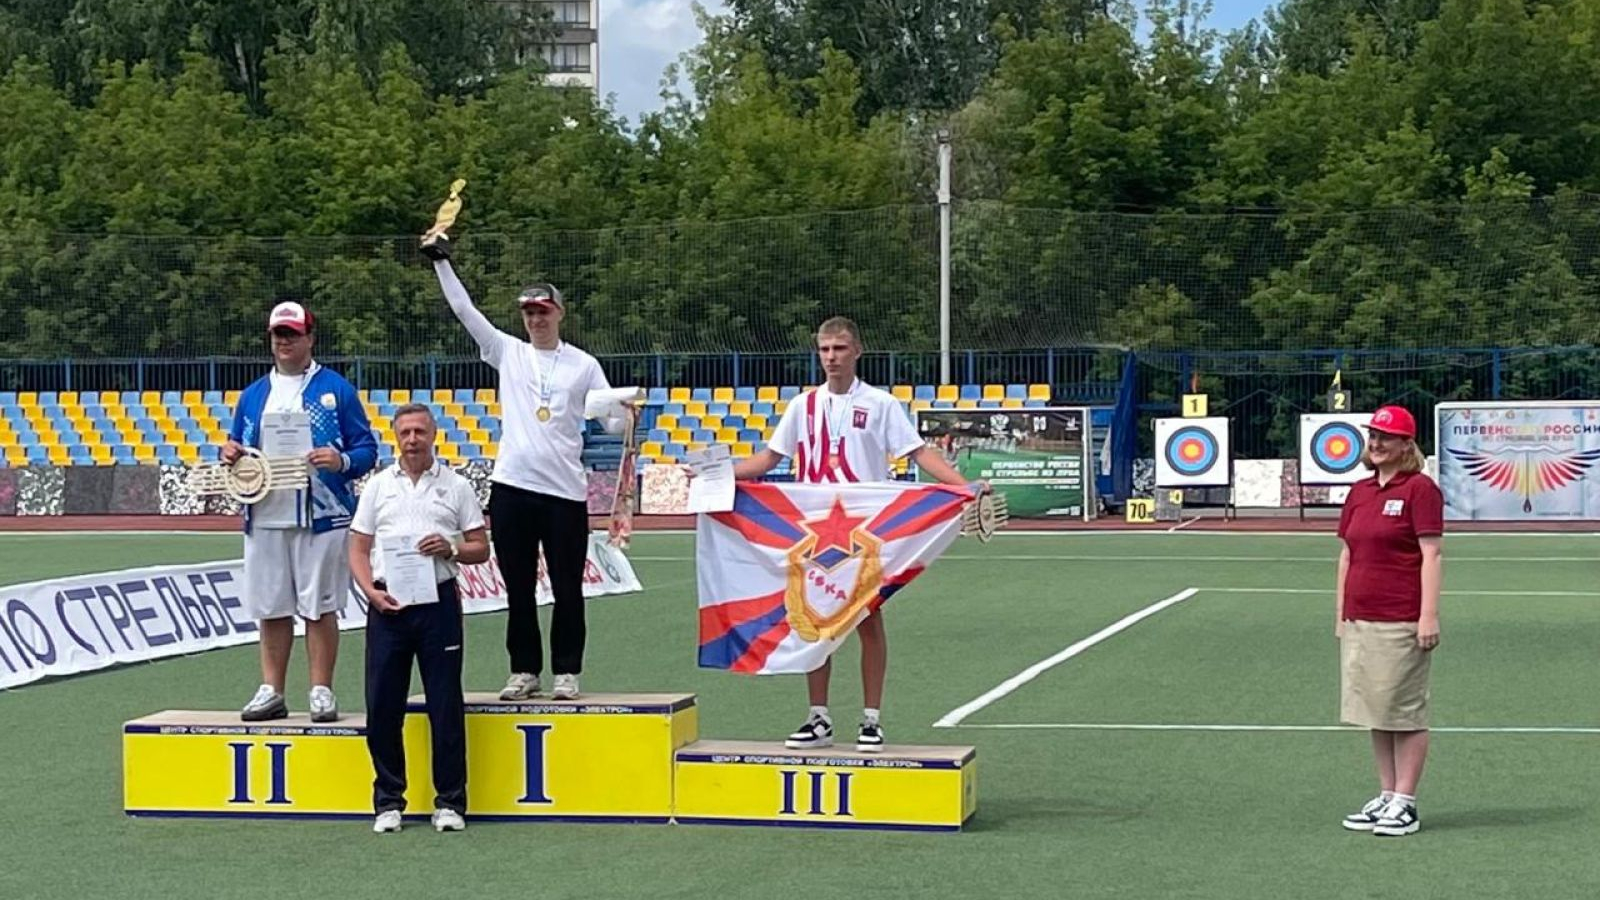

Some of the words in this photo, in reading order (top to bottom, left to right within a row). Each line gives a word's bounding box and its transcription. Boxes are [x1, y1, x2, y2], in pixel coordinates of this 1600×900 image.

[1190, 398, 1198, 413] 1
[1334, 393, 1346, 410] 2
[1453, 424, 1539, 435] ПЕРВЕНС
[1130, 503, 1146, 519] 70
[55, 571, 258, 655] СТРЕЛЬБЕ
[227, 742, 292, 804] II
[516, 724, 552, 803] I
[780, 770, 854, 816] III
